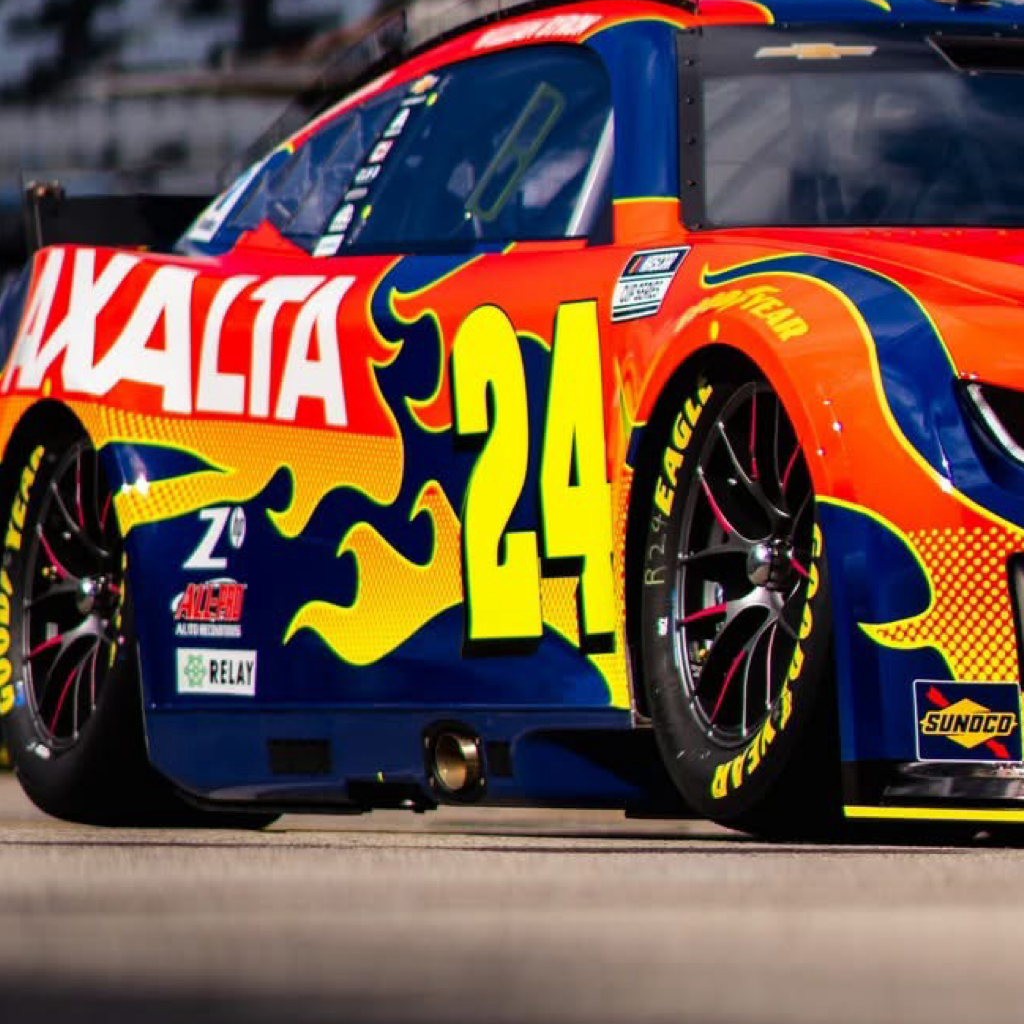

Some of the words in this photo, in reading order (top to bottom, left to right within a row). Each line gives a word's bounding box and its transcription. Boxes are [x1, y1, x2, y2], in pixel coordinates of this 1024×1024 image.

[3, 247, 355, 426] AXALTA
[451, 301, 614, 639] 24
[210, 660, 254, 685] RELAY
[926, 714, 1012, 733] SUNOCO
